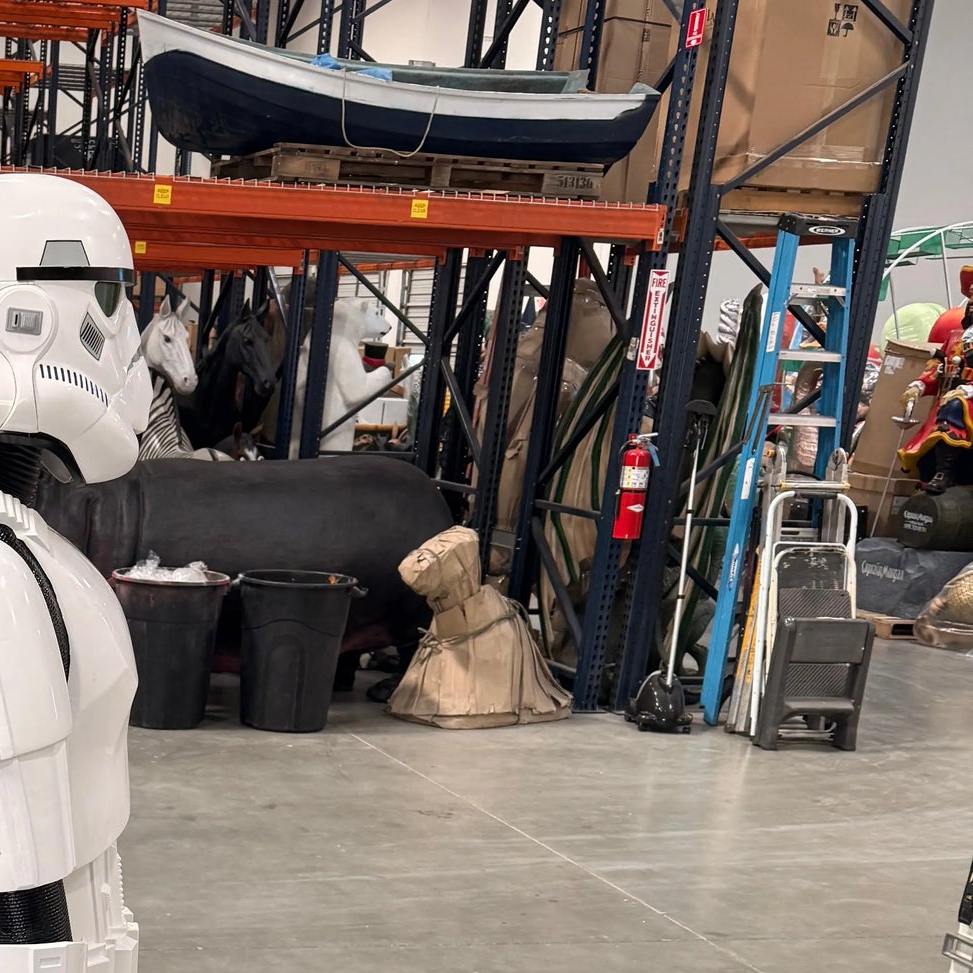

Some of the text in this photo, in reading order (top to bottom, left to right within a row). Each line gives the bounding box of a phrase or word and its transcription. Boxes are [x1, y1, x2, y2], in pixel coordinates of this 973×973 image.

[651, 277, 667, 288] FIRE
[644, 290, 661, 361] EXTINGUISHER
[861, 560, 884, 579] Captain
